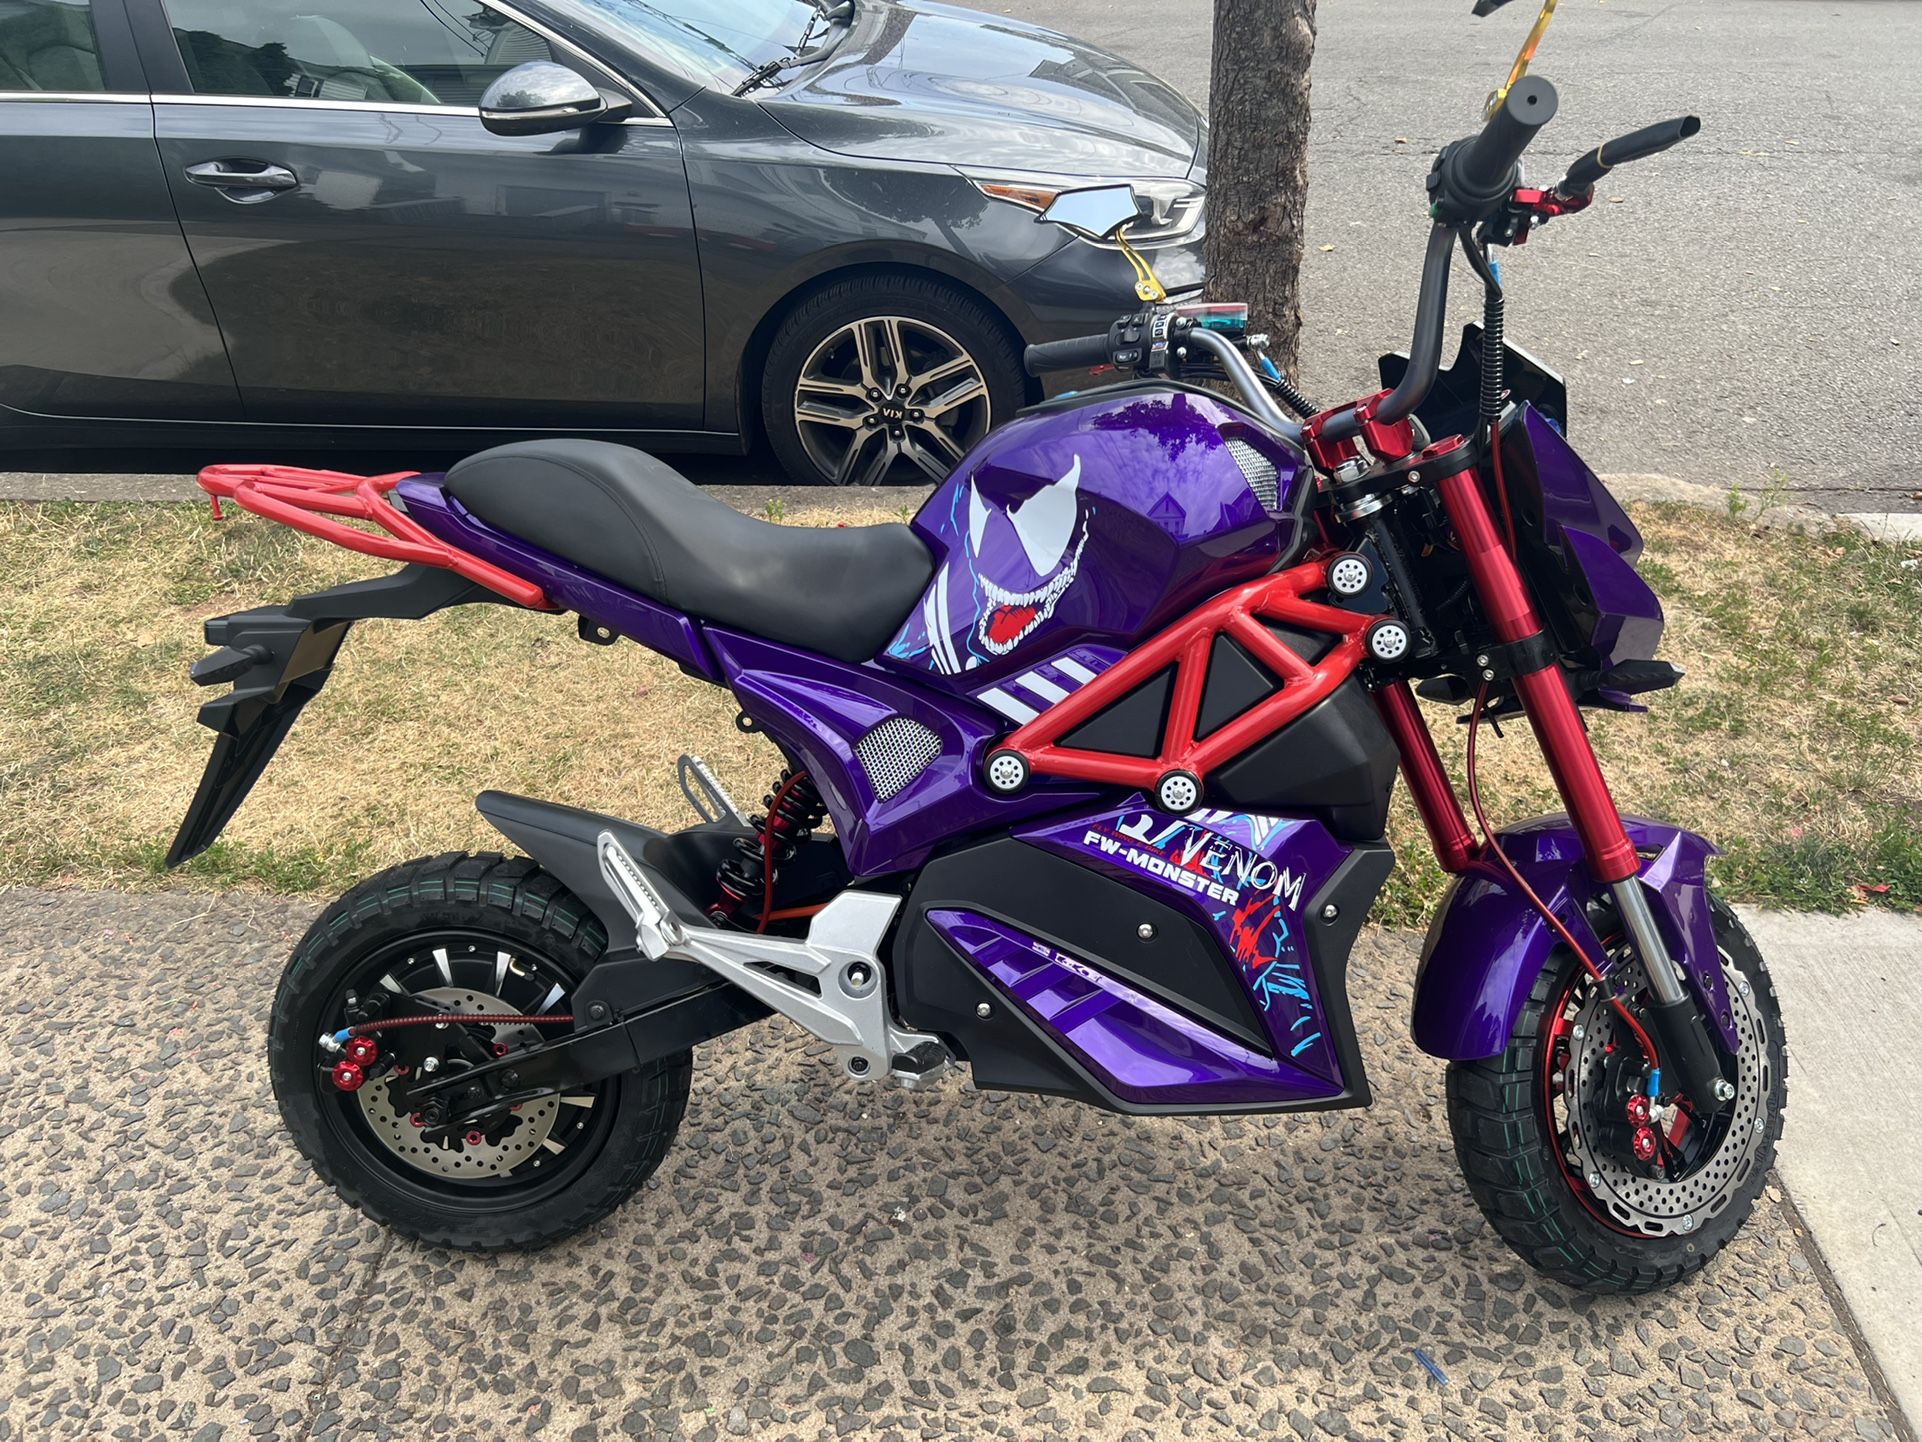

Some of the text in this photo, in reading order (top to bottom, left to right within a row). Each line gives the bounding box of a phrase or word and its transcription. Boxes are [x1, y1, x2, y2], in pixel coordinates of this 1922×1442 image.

[883, 408, 903, 419] KIA
[1083, 830, 1240, 906] FW-MONSTER
[1181, 826, 1307, 911] VENOM
